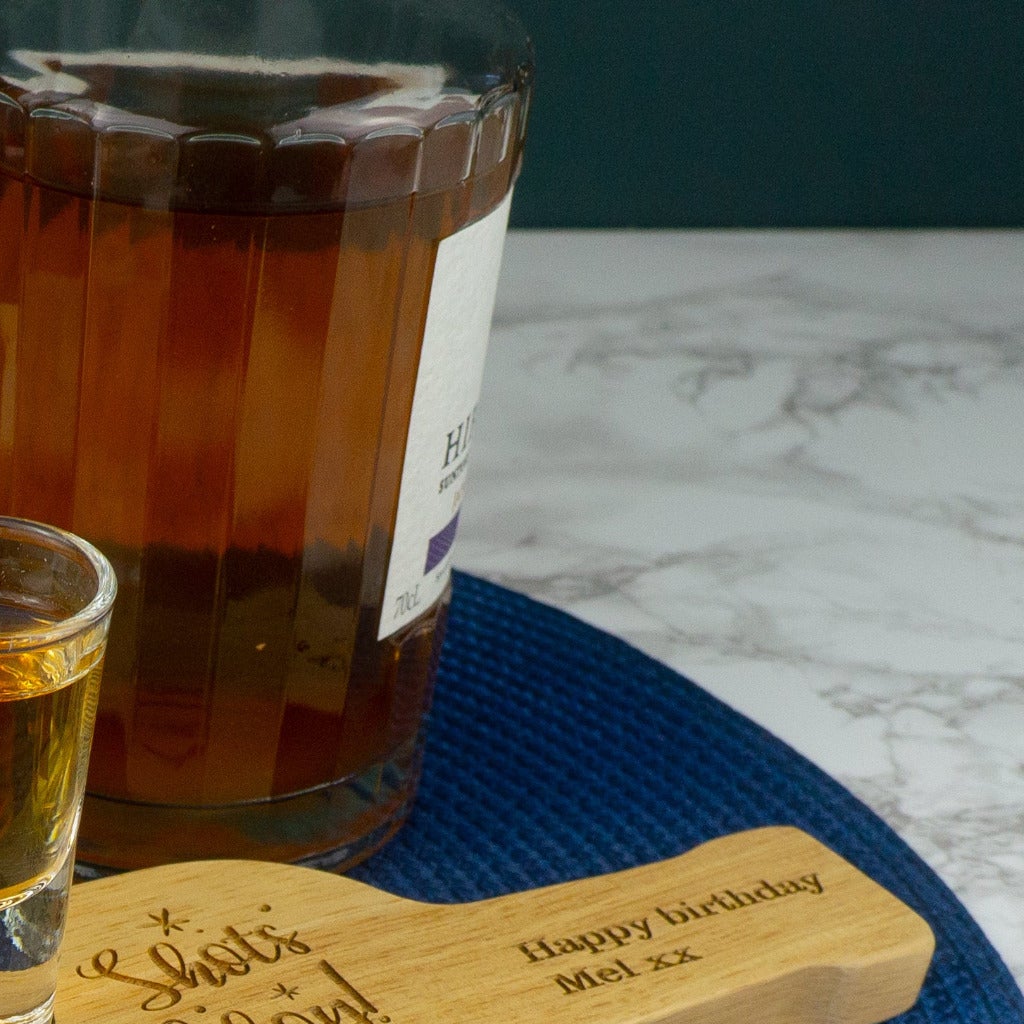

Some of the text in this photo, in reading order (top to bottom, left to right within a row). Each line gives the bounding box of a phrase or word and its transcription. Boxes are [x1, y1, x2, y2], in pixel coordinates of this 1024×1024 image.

[441, 414, 473, 470] HI
[517, 872, 825, 964] Happy birthday
[76, 924, 312, 1012] Shots
[552, 945, 703, 996] Mel xx
